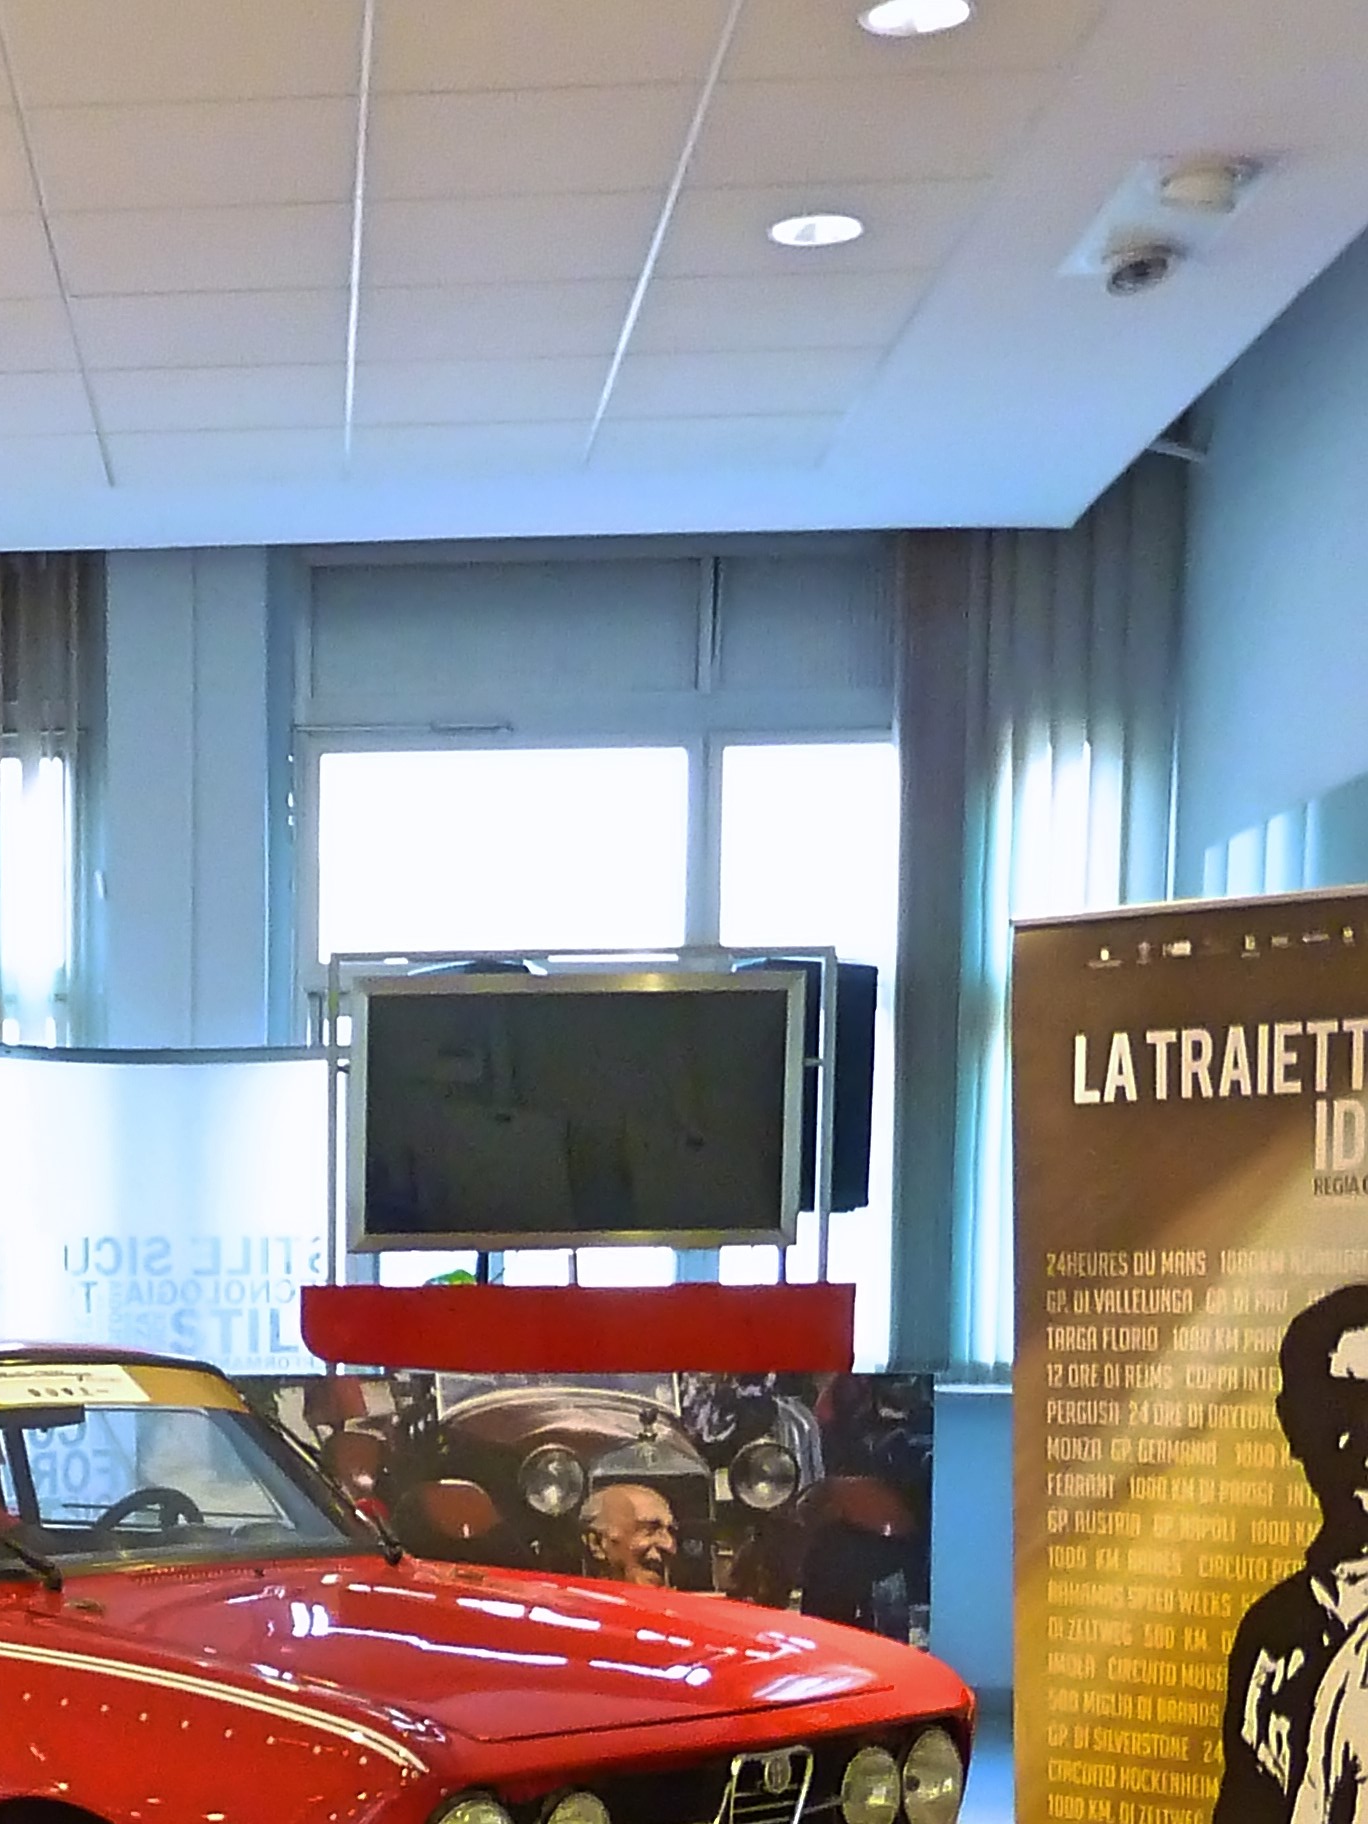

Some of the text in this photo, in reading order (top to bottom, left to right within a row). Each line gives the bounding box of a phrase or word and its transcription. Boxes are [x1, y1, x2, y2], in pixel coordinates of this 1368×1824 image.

[1073, 1018, 1368, 1105] LA TRAIETT
[1314, 1099, 1366, 1171] ID
[1313, 1176, 1360, 1197] REGIA
[1133, 1250, 1156, 1277] DU
[1161, 1250, 1206, 1277] MANS
[1073, 1288, 1090, 1314] DI
[1093, 1287, 1194, 1314] VALLELUNGA
[1046, 1325, 1098, 1351] TARGA
[1102, 1326, 1158, 1351] FLORIO
[1046, 1363, 1064, 1388] 12
[1068, 1363, 1100, 1388] ORE
[1104, 1362, 1121, 1389] DI
[1125, 1363, 1173, 1389] REIMS
[1046, 1399, 1120, 1426] PERGUSA
[1128, 1400, 1150, 1426] 24
[1188, 1403, 1204, 1429] DI
[1046, 1435, 1102, 1462] MONZA
[1138, 1437, 1217, 1467] GERMANIA
[1074, 1510, 1141, 1536] AUSTRIA
[1093, 1726, 1190, 1763] SILVERSTONE
